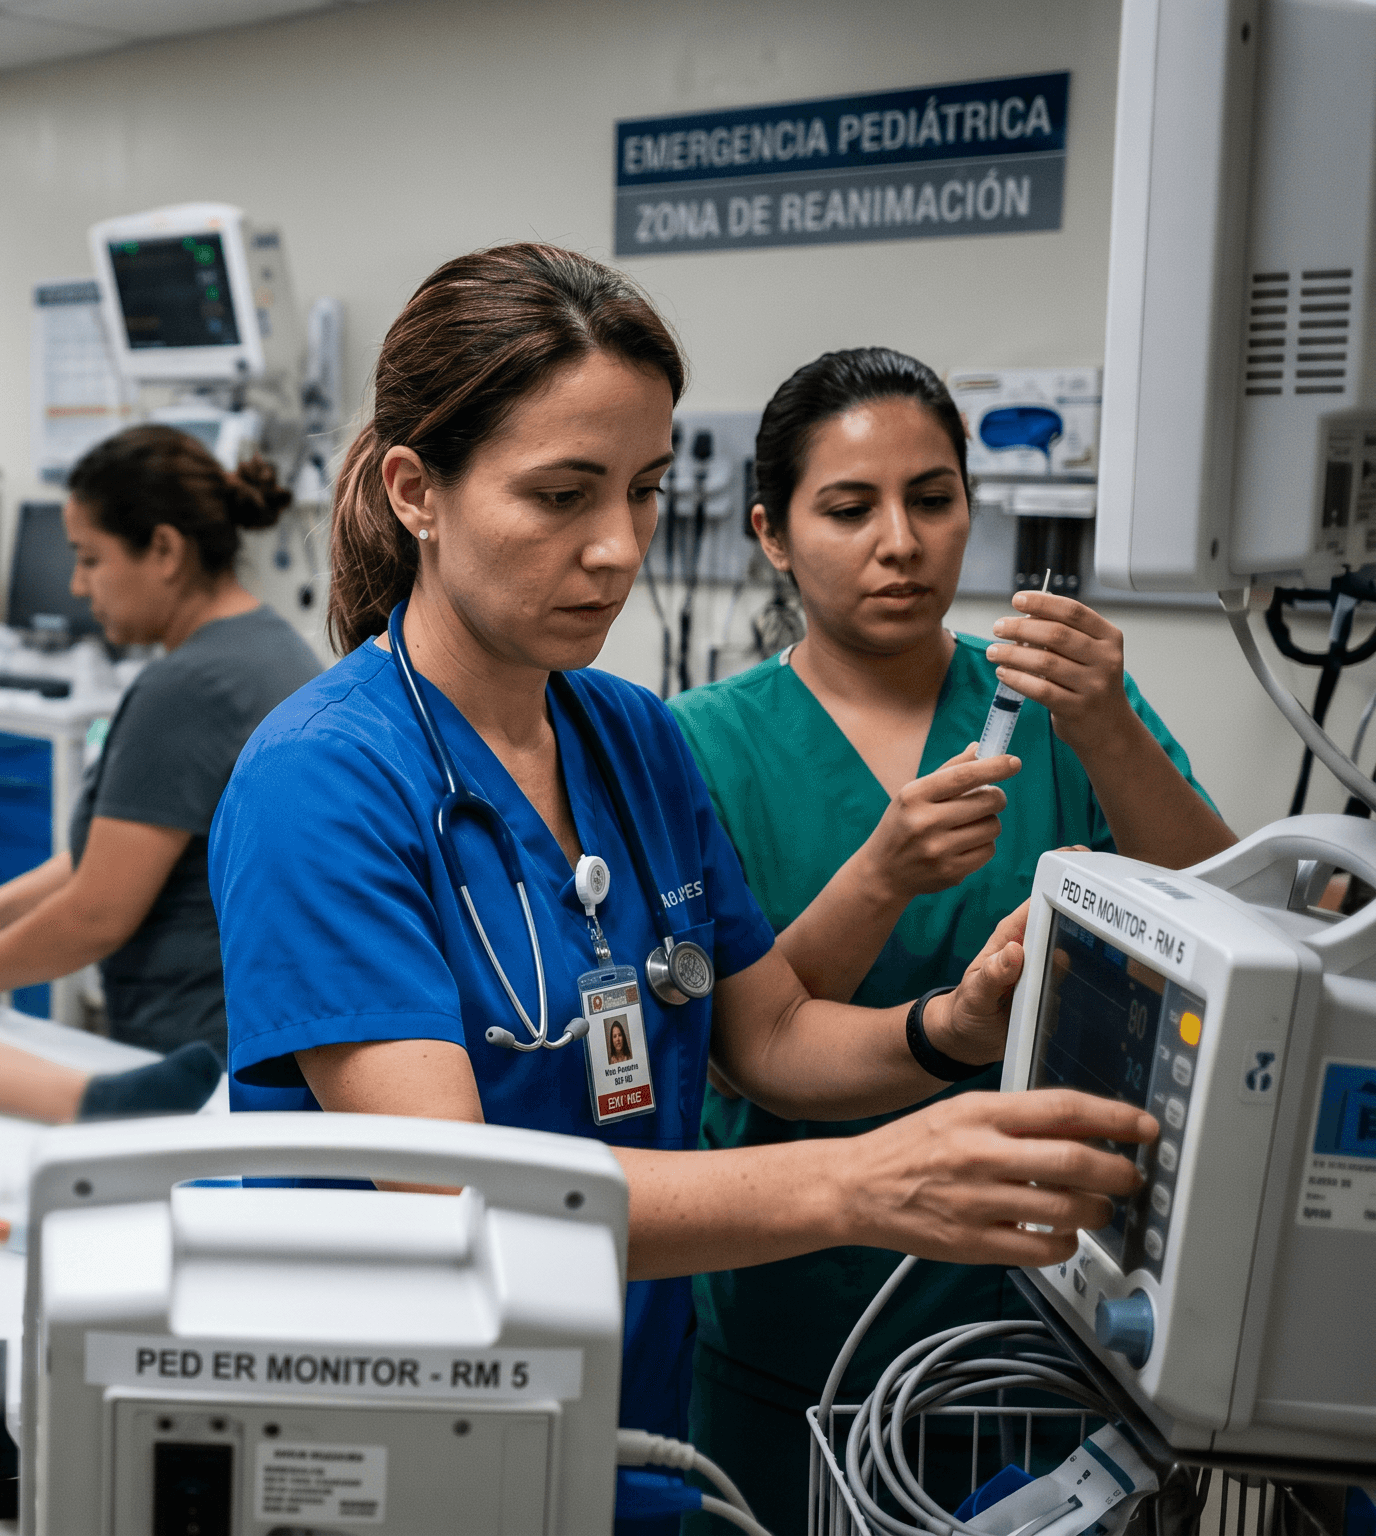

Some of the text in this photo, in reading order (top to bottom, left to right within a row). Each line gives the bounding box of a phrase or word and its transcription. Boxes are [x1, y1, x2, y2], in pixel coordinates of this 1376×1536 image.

[624, 94, 1052, 176] EMERGENCIA PEDIÁTRICA
[636, 168, 1032, 244] ZONA DE REANIMACIÓN
[1061, 878, 1082, 904] PED
[1082, 888, 1097, 914] ER
[1097, 897, 1147, 944] MONITOR
[1154, 928, 1175, 960] RM
[1176, 941, 1186, 964] 5
[136, 1348, 203, 1380] PED
[212, 1352, 256, 1382] ER
[267, 1354, 420, 1388] MONITOR
[451, 1360, 501, 1389] RM
[512, 1361, 530, 1389] 5
